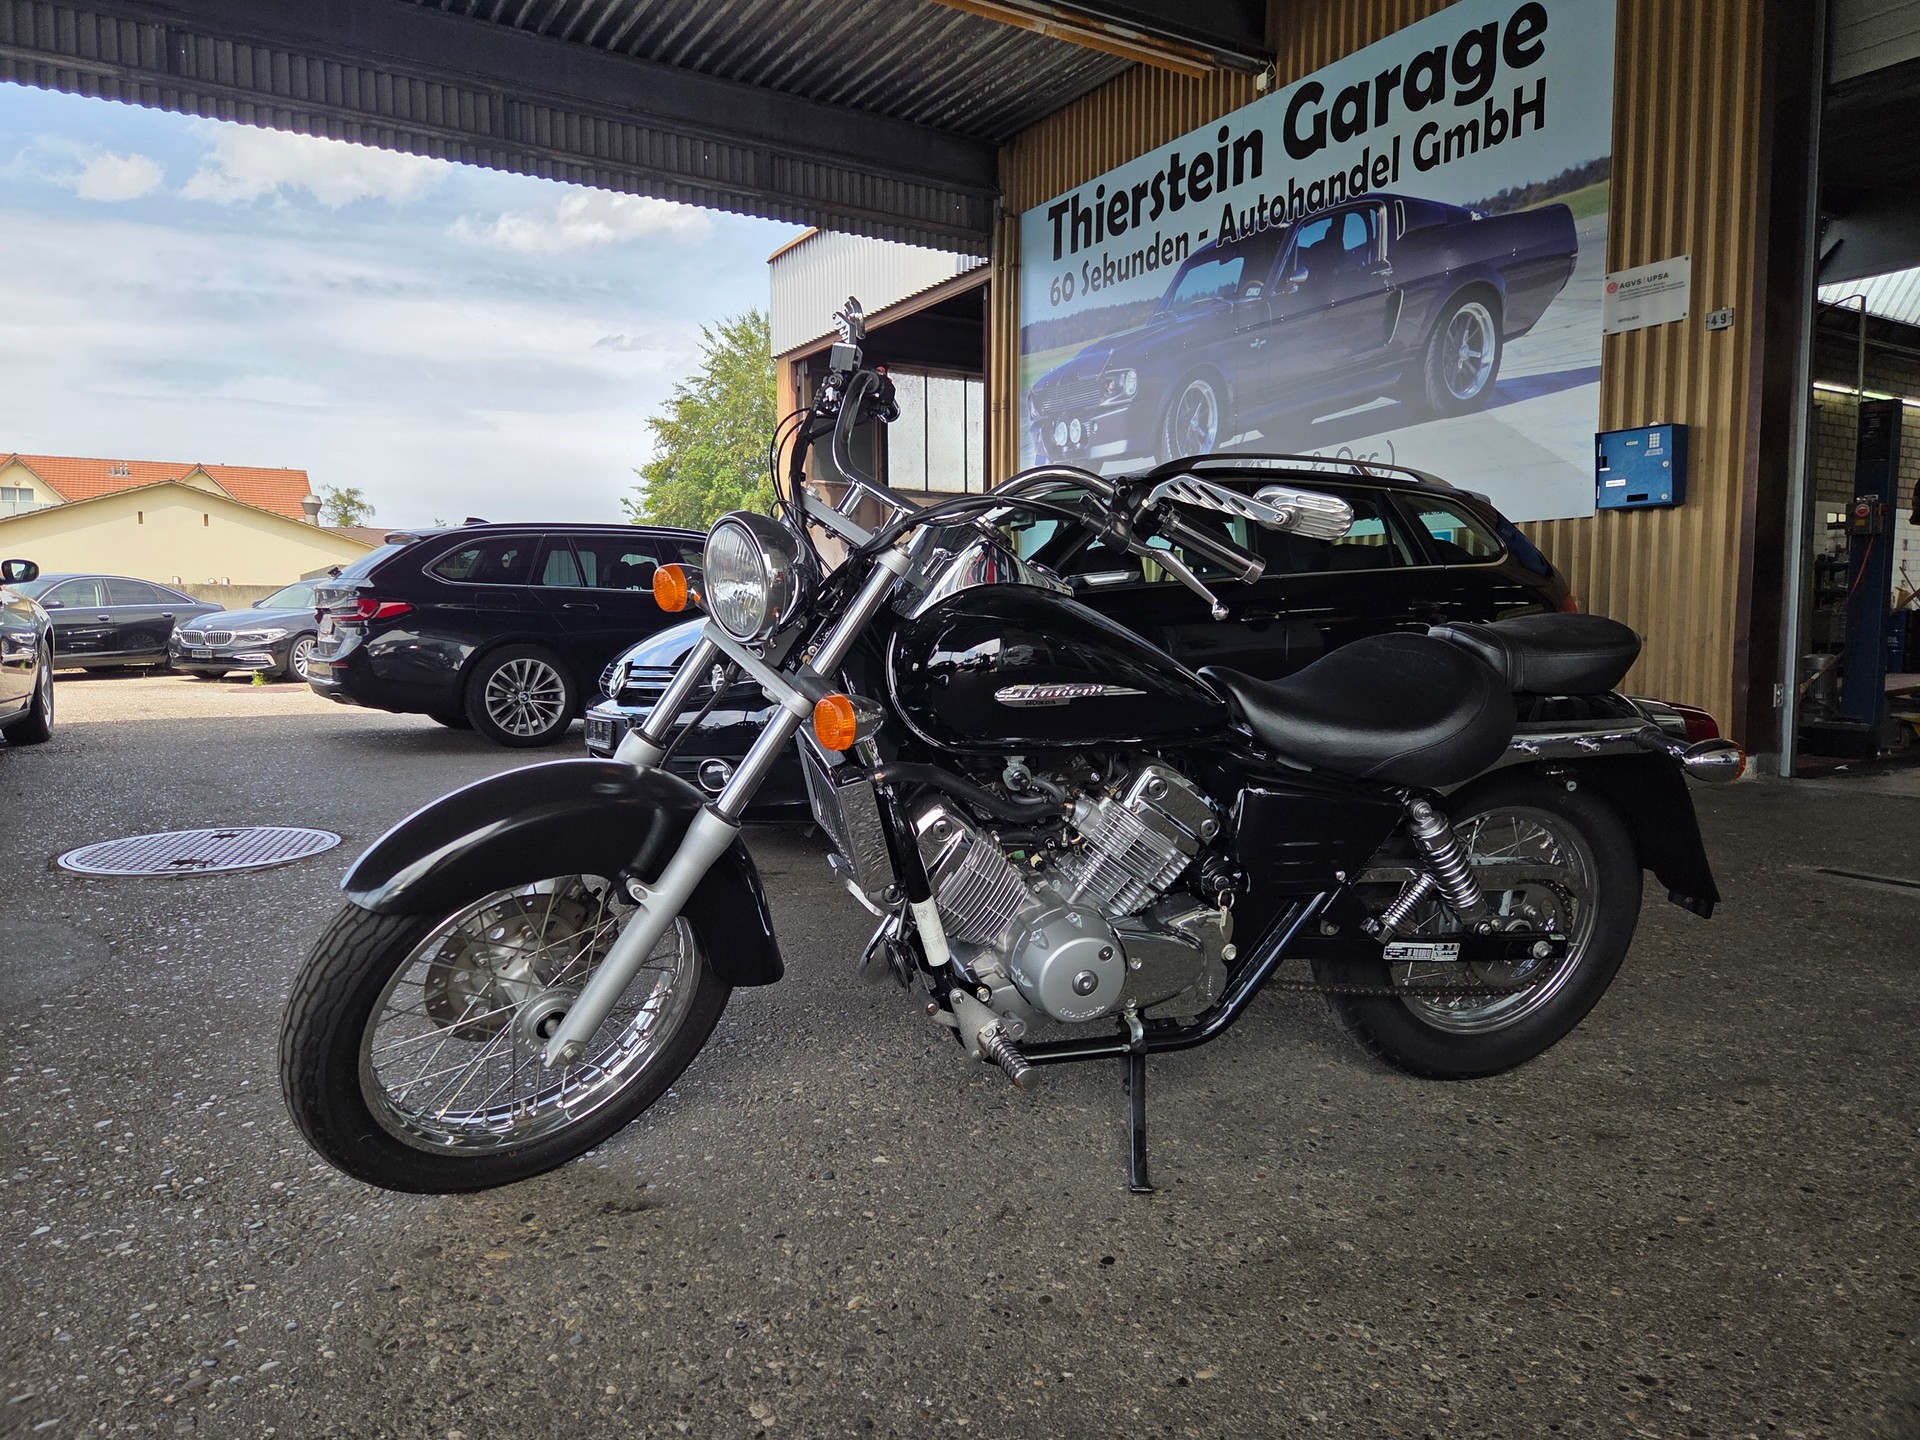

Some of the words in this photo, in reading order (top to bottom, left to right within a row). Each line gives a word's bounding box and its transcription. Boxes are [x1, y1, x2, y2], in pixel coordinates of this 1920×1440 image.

[1048, 125, 1263, 261] Thierstein
[1283, 2, 1547, 160] Garage
[1050, 272, 1075, 306] 60
[1081, 231, 1189, 297] Sekunden
[1217, 135, 1400, 247] Autohandel
[1413, 77, 1546, 172] GmbH
[1619, 278, 1642, 289] AGVS
[1647, 272, 1669, 283] UPSA
[1711, 312, 1726, 326] 49
